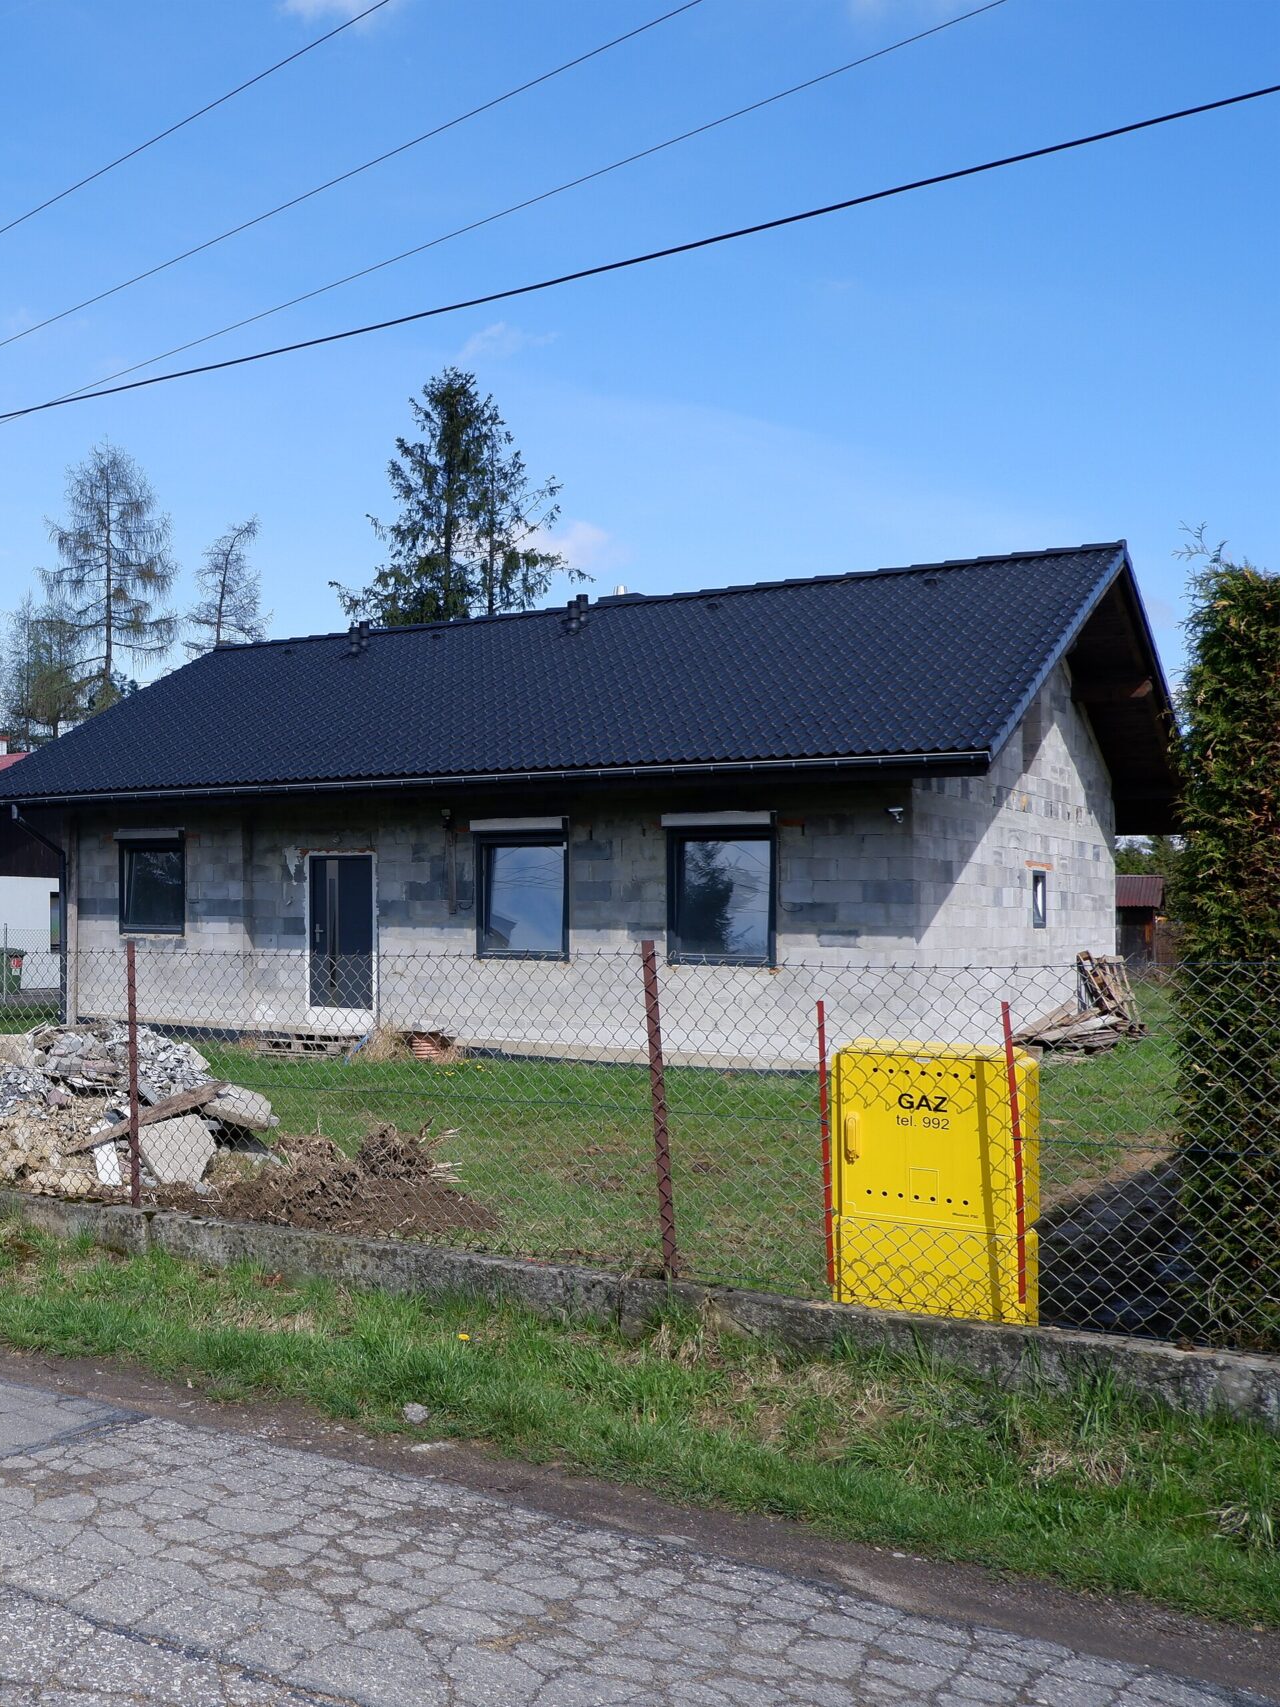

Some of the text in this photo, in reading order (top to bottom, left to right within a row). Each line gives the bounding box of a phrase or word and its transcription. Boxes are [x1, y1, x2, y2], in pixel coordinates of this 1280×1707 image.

[897, 1093, 948, 1113] GAZ
[895, 1114, 950, 1131] tel. 992
